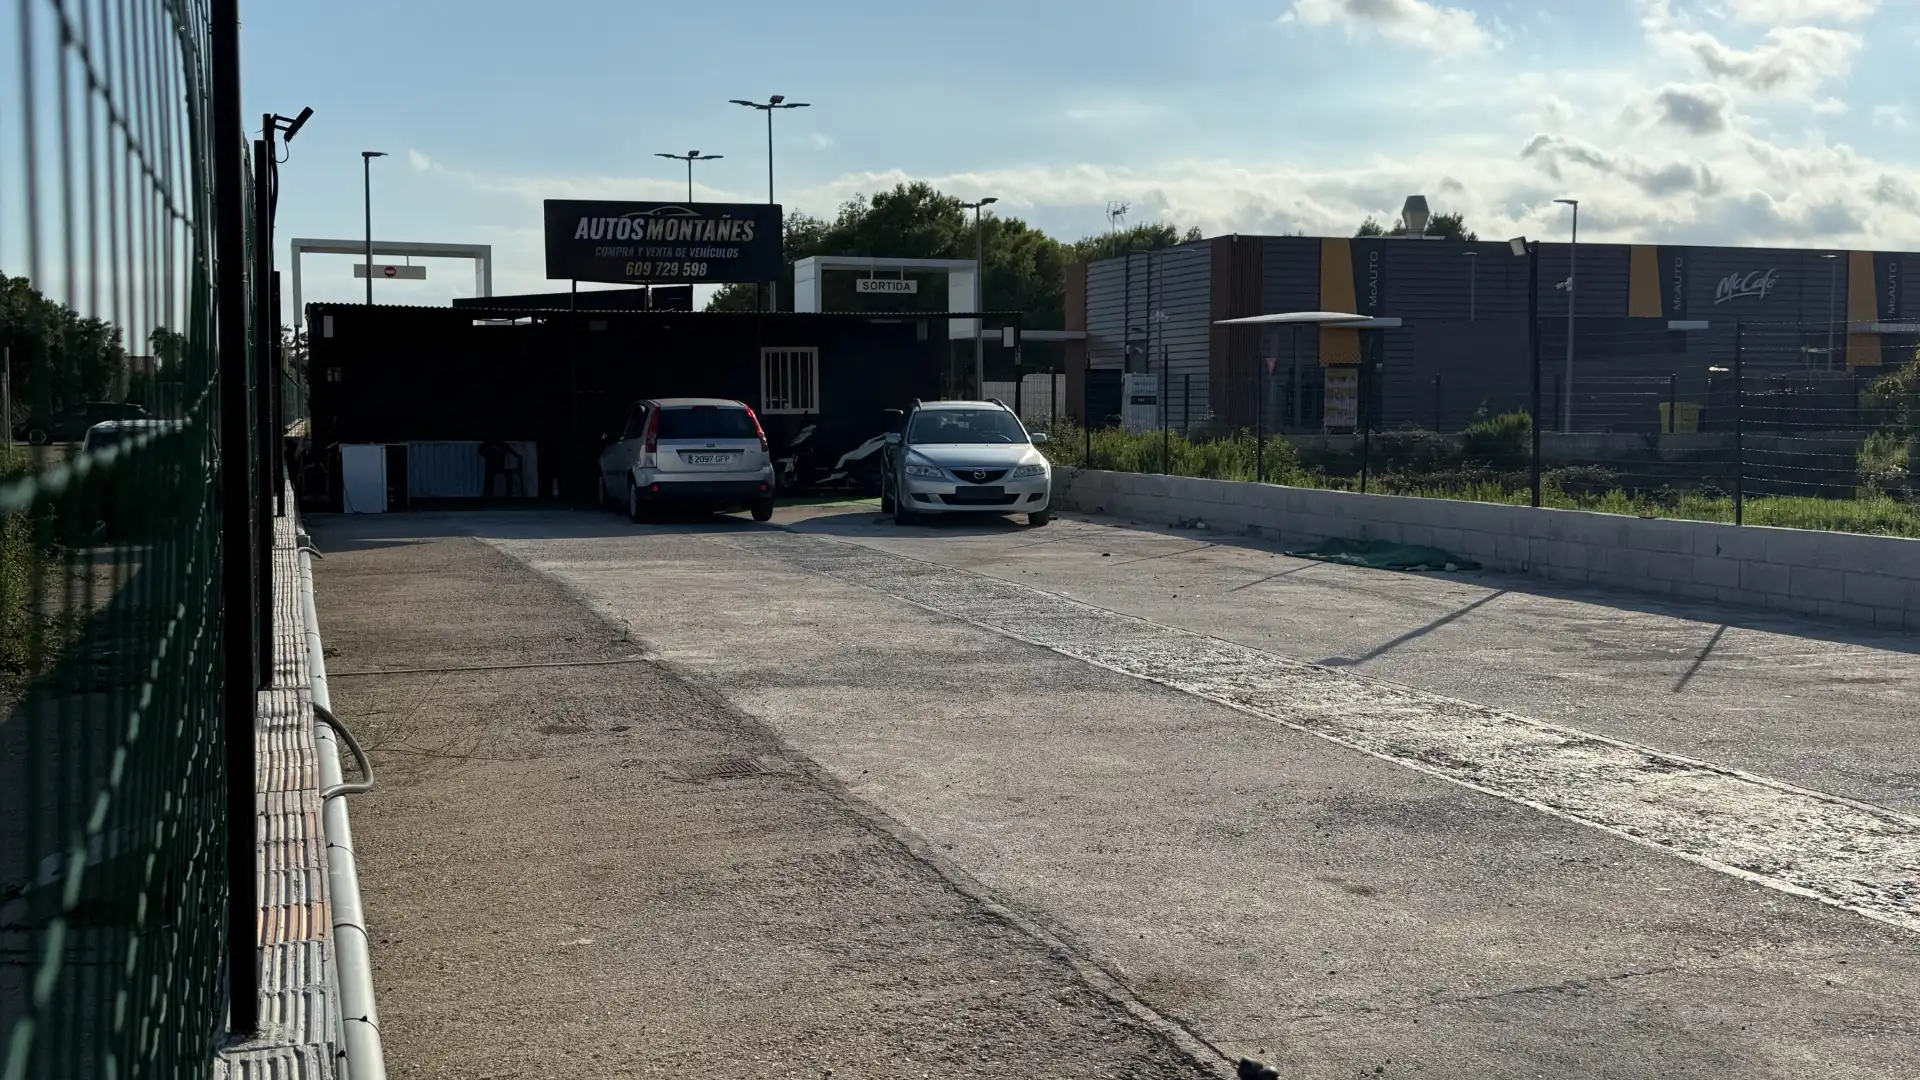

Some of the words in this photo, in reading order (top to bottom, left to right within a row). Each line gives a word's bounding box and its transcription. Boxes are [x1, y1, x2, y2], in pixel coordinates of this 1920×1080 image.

[574, 217, 645, 240] AUTOS
[646, 214, 756, 242] MONTAÑES
[595, 246, 634, 258] COMPRA
[637, 246, 644, 258] Y
[645, 246, 673, 258] VENTA
[675, 247, 686, 258] DE
[689, 245, 739, 259] VEHÍCULOS
[626, 262, 651, 276] 609
[654, 262, 679, 277] 729
[683, 262, 708, 277] 598
[1369, 251, 1379, 307] McAUTO
[862, 281, 911, 291] SORTIDA
[1673, 257, 1683, 310] McAUTO
[1714, 267, 1780, 301] McCafé
[694, 455, 714, 463] 2097
[715, 455, 730, 463] GFP
